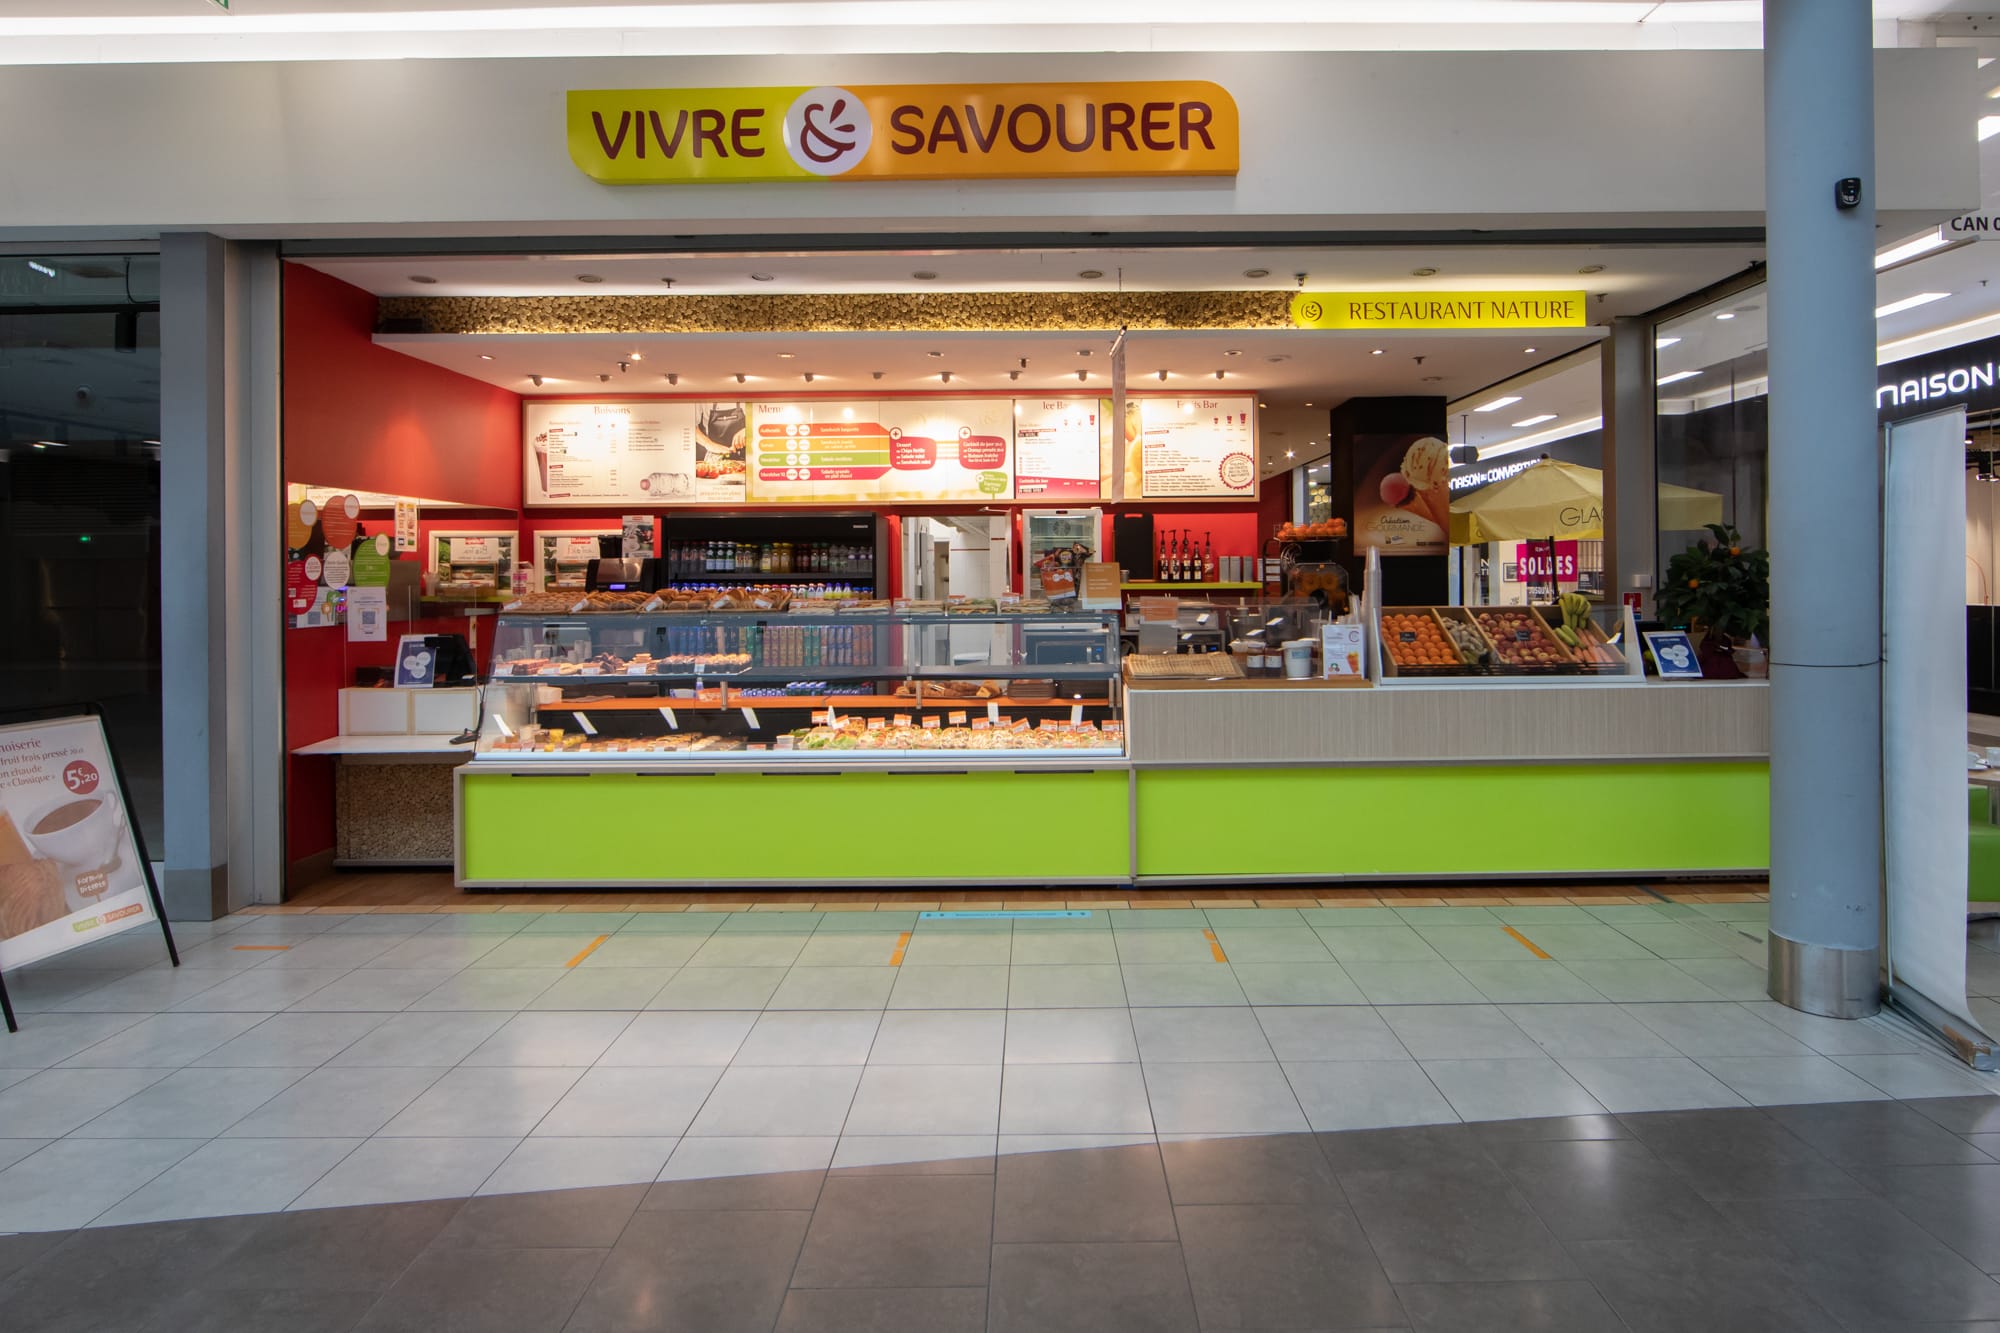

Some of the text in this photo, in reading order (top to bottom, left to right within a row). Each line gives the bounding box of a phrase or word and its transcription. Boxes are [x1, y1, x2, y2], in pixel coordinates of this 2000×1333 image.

[591, 108, 766, 160] VIVRE
[890, 101, 1216, 155] SAVOURER
[1950, 216, 1989, 232] CAN
[1348, 300, 1575, 321] RESTAURANT NATURE
[1202, 400, 1220, 409] Bar
[1559, 506, 1604, 527] GLA
[1519, 554, 1574, 576] SOLDES
